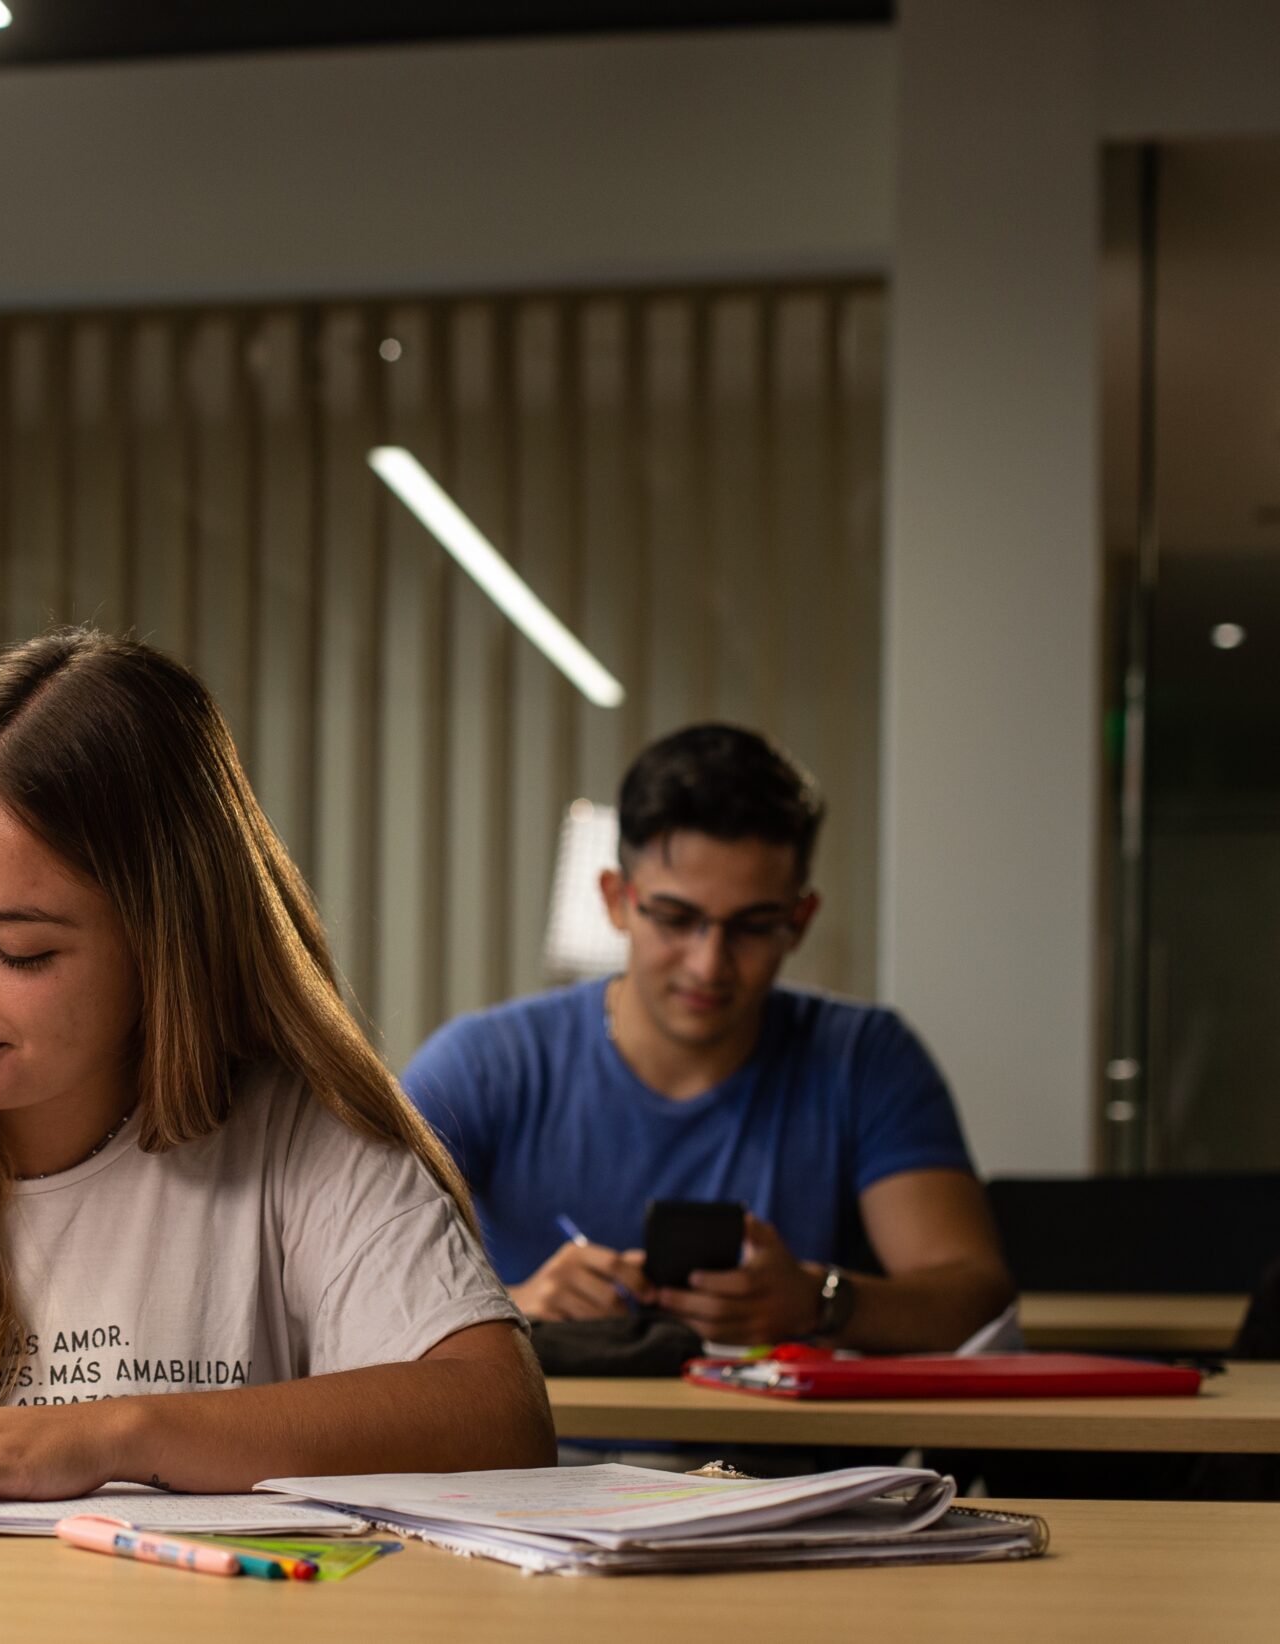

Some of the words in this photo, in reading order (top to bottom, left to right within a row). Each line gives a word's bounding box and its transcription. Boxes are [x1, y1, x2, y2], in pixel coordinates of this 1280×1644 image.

[53, 1325, 130, 1353] AMOR.
[49, 1357, 101, 1386] MÁS
[116, 1358, 253, 1385] AMABILIDA
